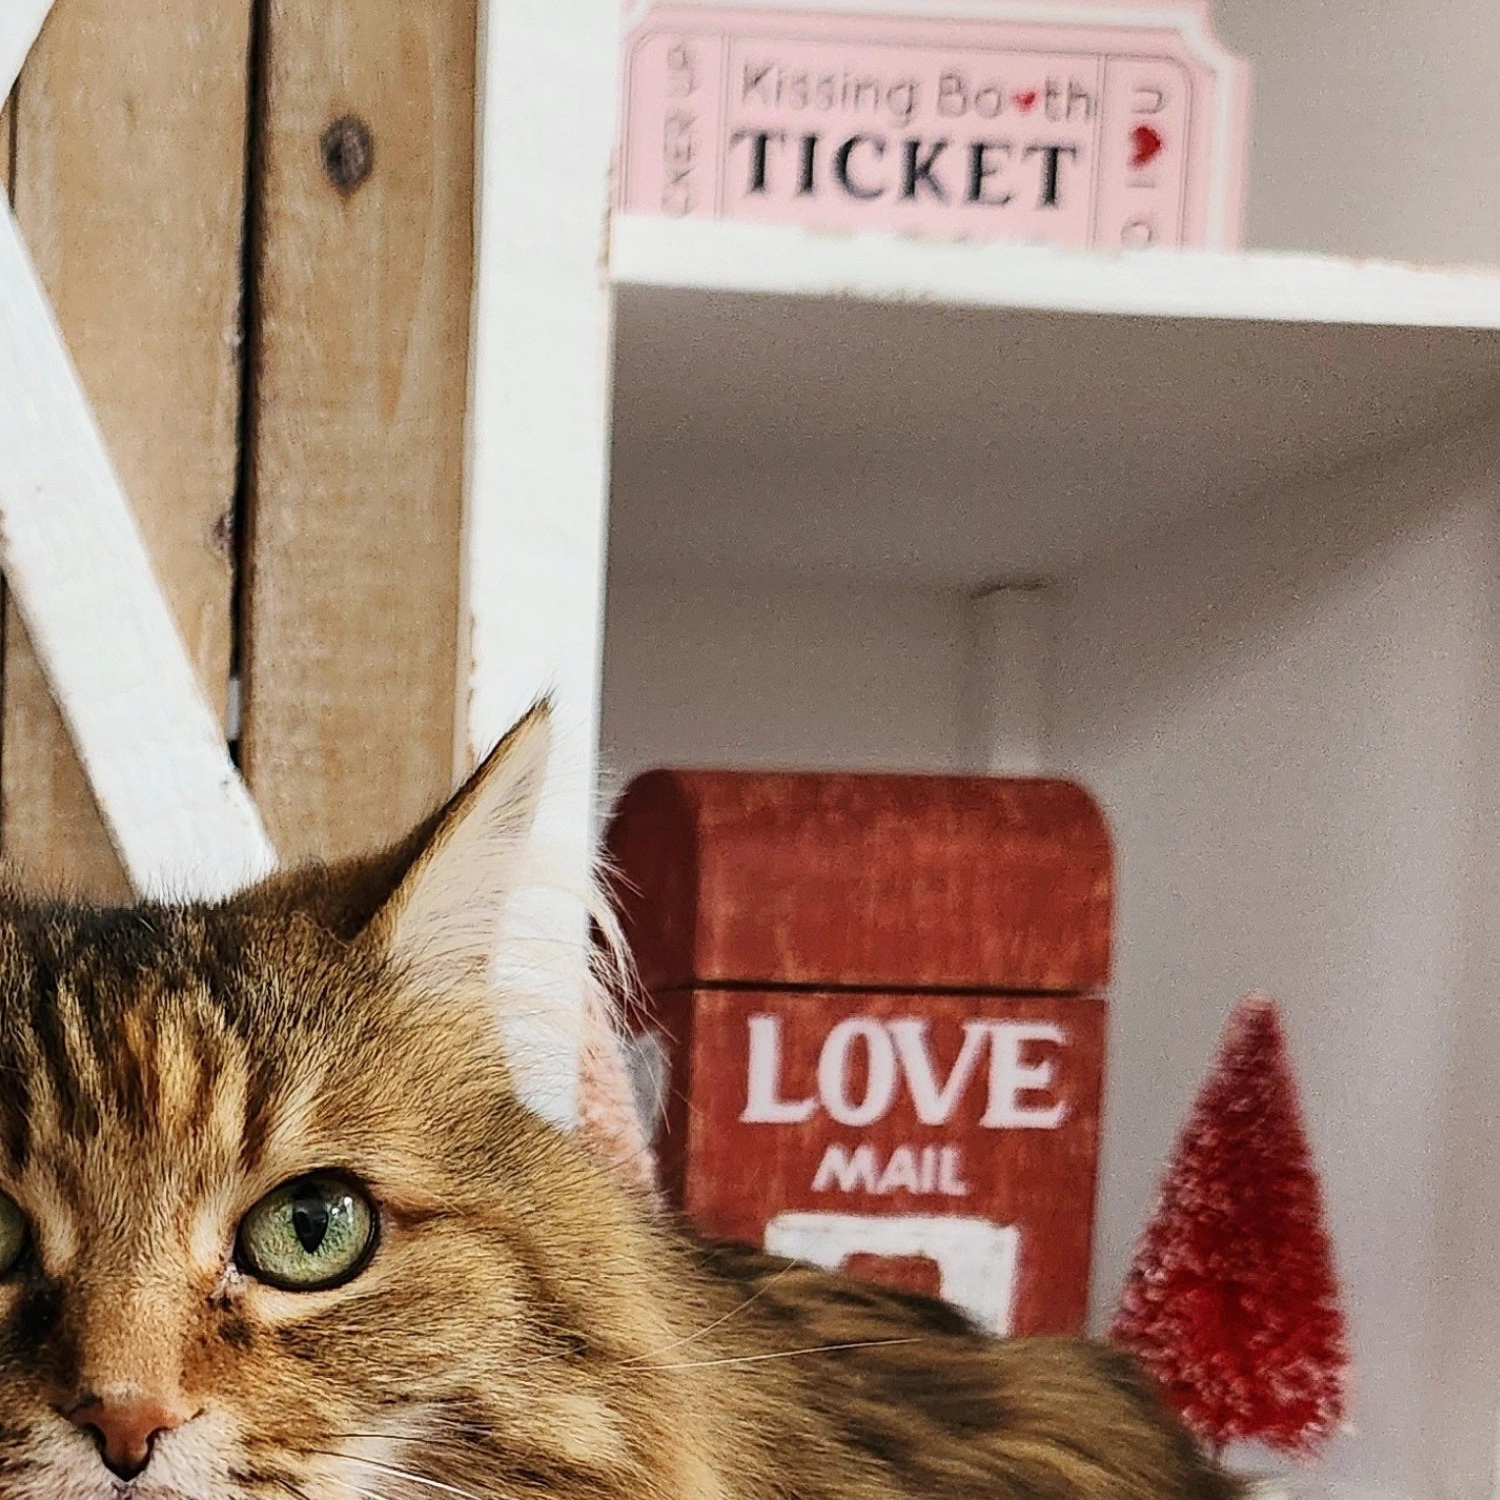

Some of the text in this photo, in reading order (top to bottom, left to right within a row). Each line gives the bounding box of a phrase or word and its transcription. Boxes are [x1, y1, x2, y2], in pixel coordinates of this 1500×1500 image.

[743, 60, 920, 128] Kissing
[729, 128, 1080, 209] TICKET
[740, 1012, 1066, 1129] LOVE
[812, 1144, 970, 1197] MAIL
